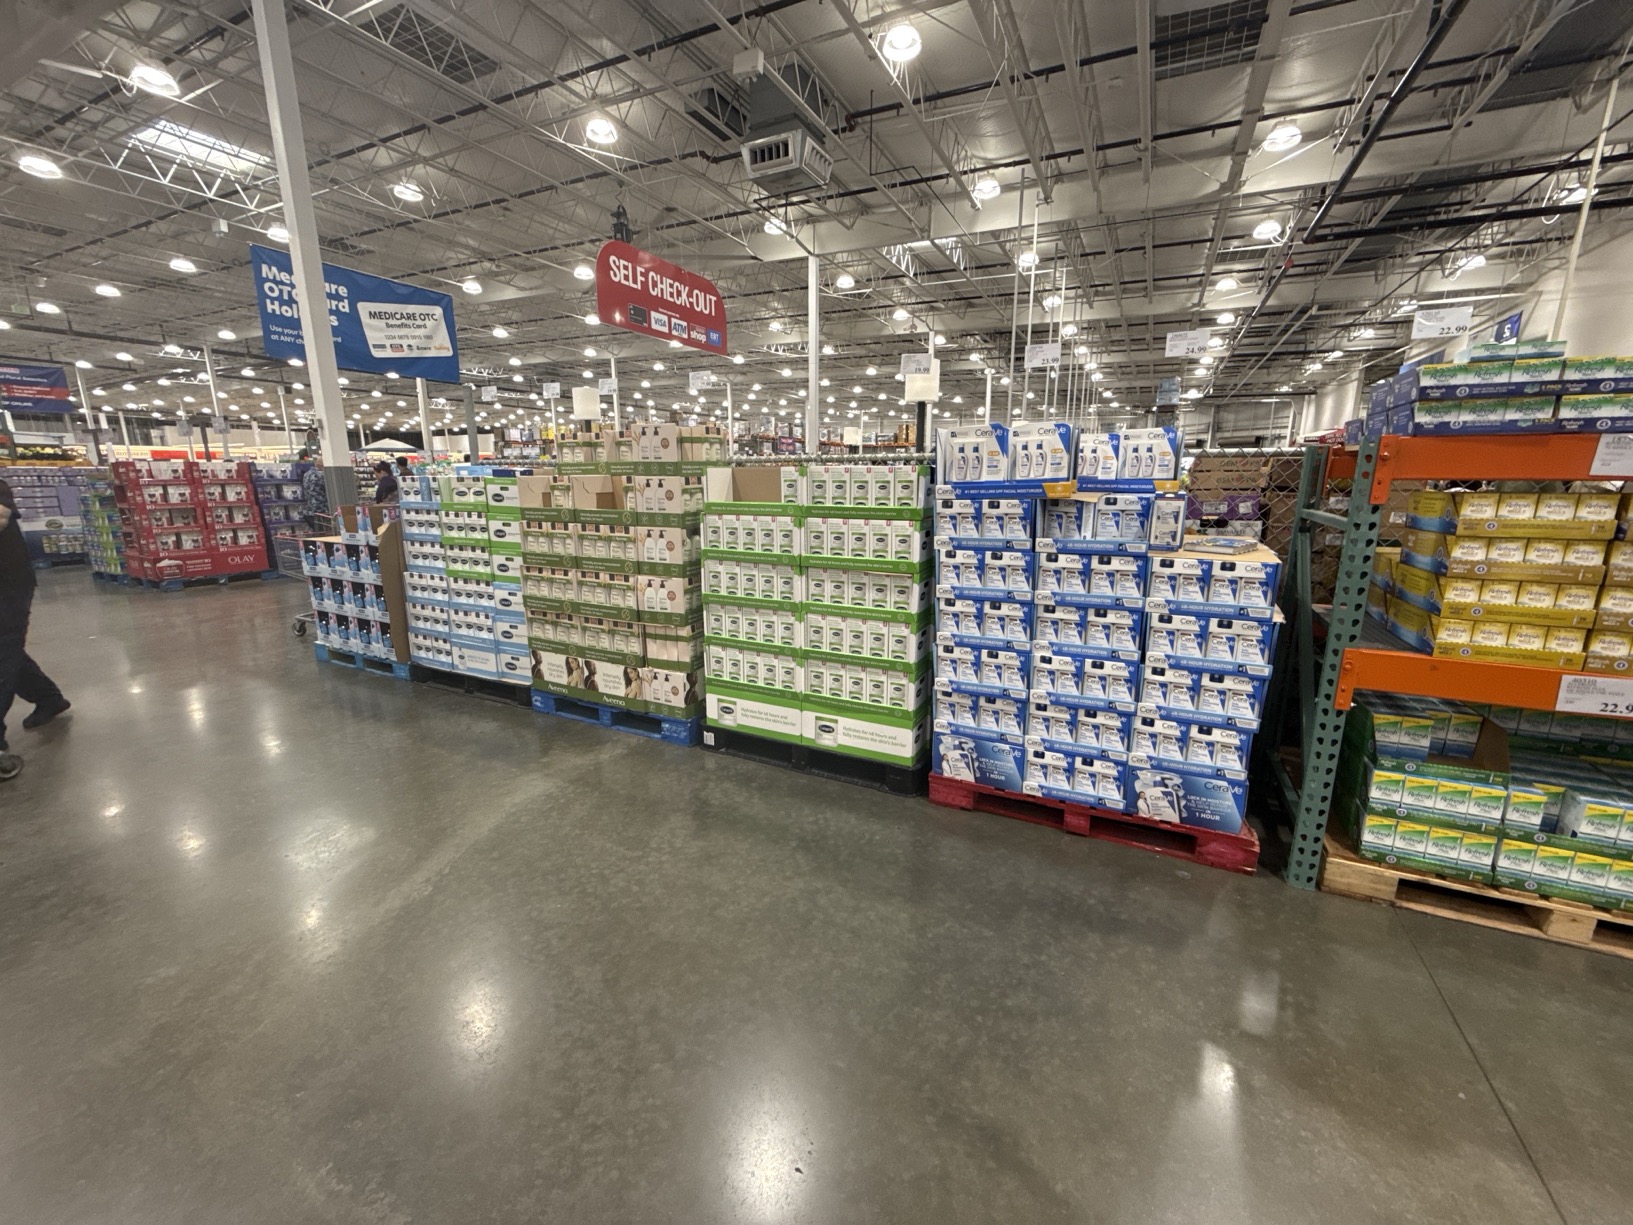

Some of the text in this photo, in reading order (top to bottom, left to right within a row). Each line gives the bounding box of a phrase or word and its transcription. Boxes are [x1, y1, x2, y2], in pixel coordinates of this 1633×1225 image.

[609, 255, 717, 316] SELF CHECK-OUT
[266, 299, 339, 326] Hols
[369, 311, 438, 322] MEDICARE OTC
[653, 316, 667, 328] VISA
[269, 324, 282, 333] Use
[283, 327, 298, 336] your
[672, 321, 687, 334] ATM
[1439, 326, 1468, 335] 22.99
[280, 335, 295, 344] ANY
[690, 330, 707, 344] shop
[710, 332, 719, 341] EBT
[1185, 346, 1207, 355] 24.99
[1474, 370, 1502, 378] Refresh
[1522, 367, 1552, 377] Refresh
[1574, 365, 1605, 374] Refresh
[1430, 372, 1458, 380] Refresh
[975, 429, 1003, 437] CeraVe
[1038, 426, 1066, 435] CeraVe
[937, 487, 961, 496] CeraVe
[1037, 541, 1063, 549] CeraVe
[228, 555, 255, 564] OLAY
[1119, 557, 1143, 566] CeraVe
[1182, 562, 1208, 570] CeraVe
[1244, 565, 1273, 574] CeraVe
[1036, 593, 1061, 602] CeraVe
[1148, 601, 1176, 610] CeraVe
[1180, 618, 1205, 627] CeraVe
[1241, 623, 1269, 632] CeraVe
[1148, 655, 1175, 665] CeraVe
[1173, 671, 1198, 680] CeraVe
[1232, 677, 1259, 687] CeraVe
[548, 684, 568, 694] Aveeno
[602, 696, 625, 706] Aveeno
[1139, 706, 1167, 716] CeraVe
[1162, 721, 1187, 732] CeraVe
[1453, 727, 1478, 735] Refresh
[1220, 730, 1247, 740] CeraVe
[1376, 728, 1398, 736] Refresh
[992, 745, 1021, 758] CeraVe
[1131, 755, 1157, 765] CeraVe
[990, 773, 1005, 781] HOUR
[1204, 781, 1243, 795] CeraVe
[1376, 785, 1400, 794] Refresh
[1408, 790, 1433, 800] Refresh
[1440, 796, 1466, 805] Refresh
[1474, 801, 1500, 811] Refresh
[1512, 807, 1540, 816] Refresh
[1200, 812, 1221, 821] HOUR
[1586, 819, 1616, 829] Refresh
[1368, 829, 1392, 838] Refresh
[1400, 835, 1424, 845] Refresh
[1432, 841, 1457, 851] Refresh
[1465, 847, 1491, 857] Refresh
[1503, 854, 1531, 865] Refresh
[1539, 860, 1568, 871] Refresh
[1576, 868, 1606, 879] Refresh
